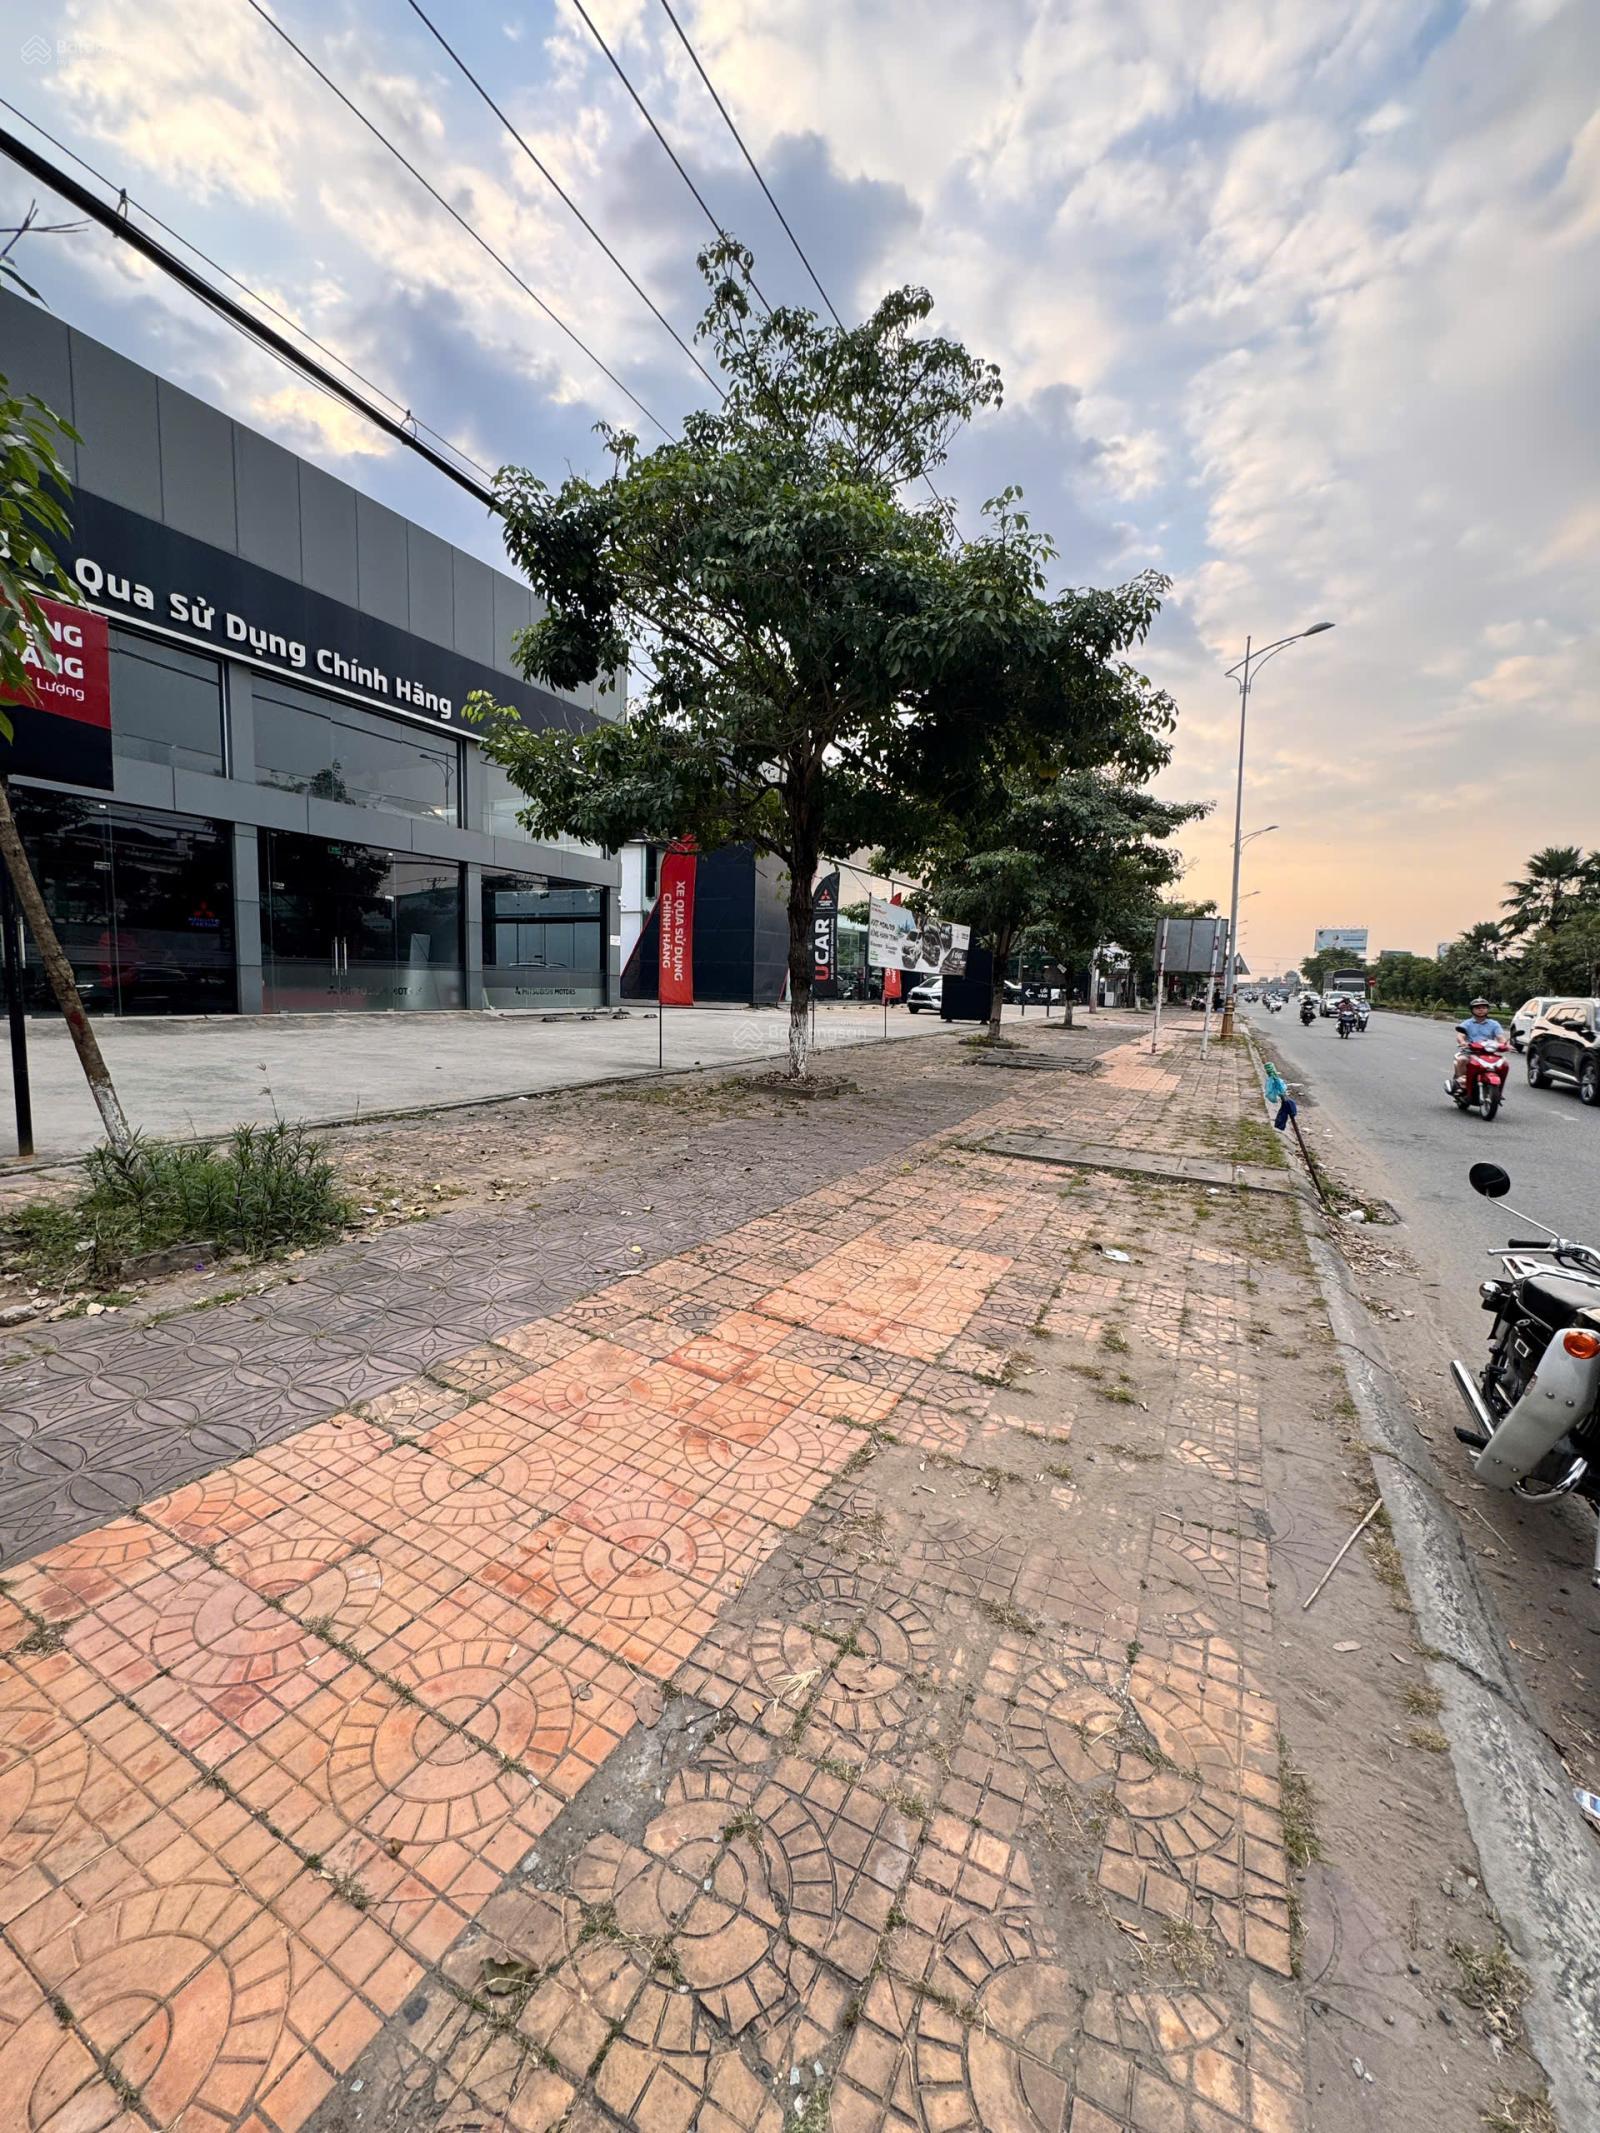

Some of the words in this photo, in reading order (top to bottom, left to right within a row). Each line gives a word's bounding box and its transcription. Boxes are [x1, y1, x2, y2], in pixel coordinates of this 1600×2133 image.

[75, 558, 154, 611] Qua
[169, 593, 215, 631] Sử
[226, 613, 306, 668] Dụng
[317, 649, 388, 693] Chính
[396, 677, 452, 719] Hãng
[36, 677, 85, 701] Lượng
[676, 881, 686, 897] XE
[662, 893, 674, 931] CHÍNH
[674, 899, 685, 926] QUA
[662, 933, 673, 969] HÃNG
[675, 928, 686, 945] SỬ
[815, 919, 830, 980] UCAR
[673, 947, 683, 981] DỤNG
